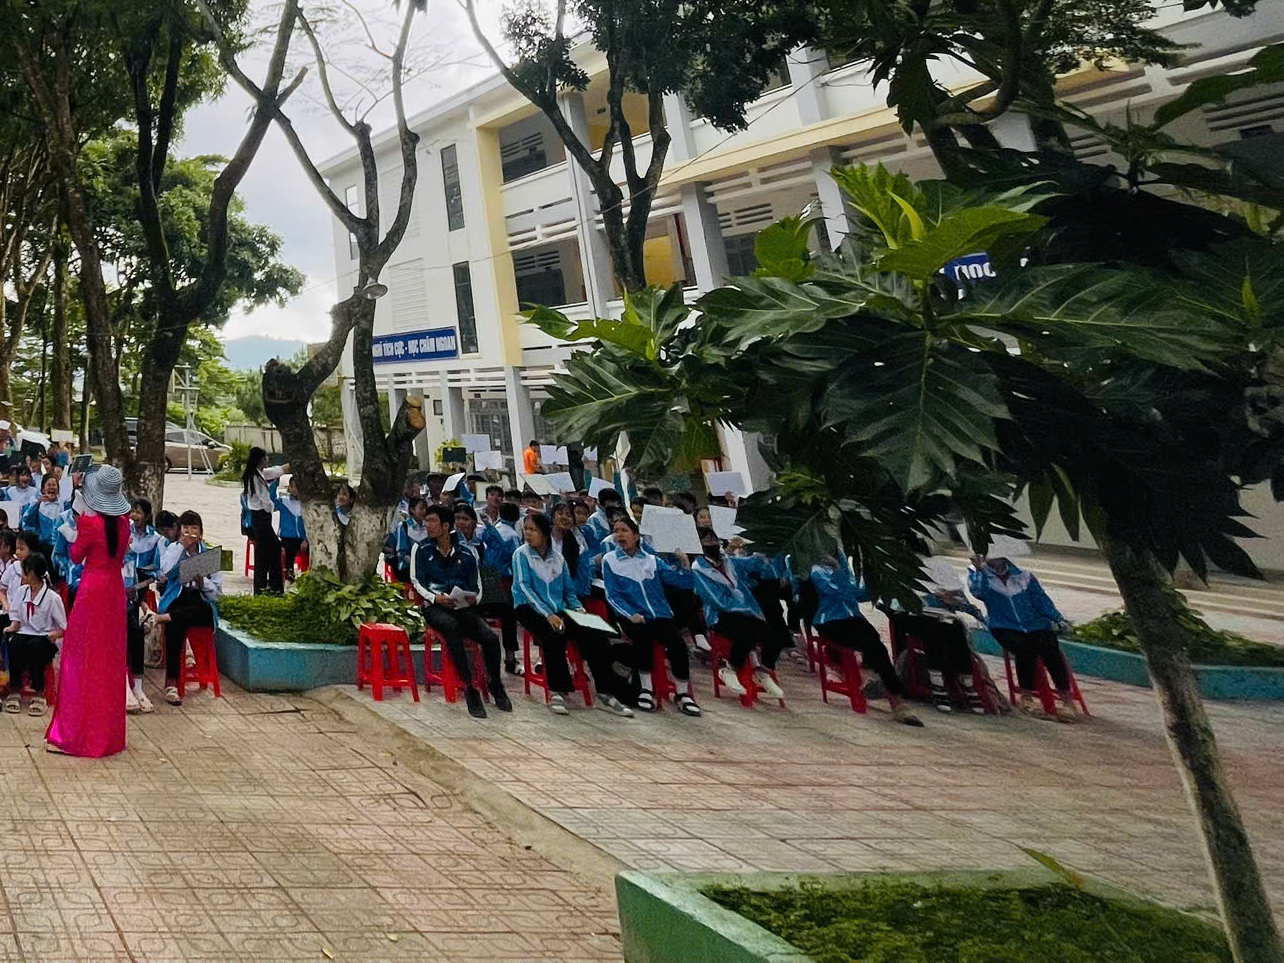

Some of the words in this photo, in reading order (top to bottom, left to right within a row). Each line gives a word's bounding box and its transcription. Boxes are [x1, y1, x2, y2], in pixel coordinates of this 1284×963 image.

[407, 339, 419, 357] HỌC
[419, 335, 436, 353] CHĂM
[436, 335, 456, 352] NGOAN
